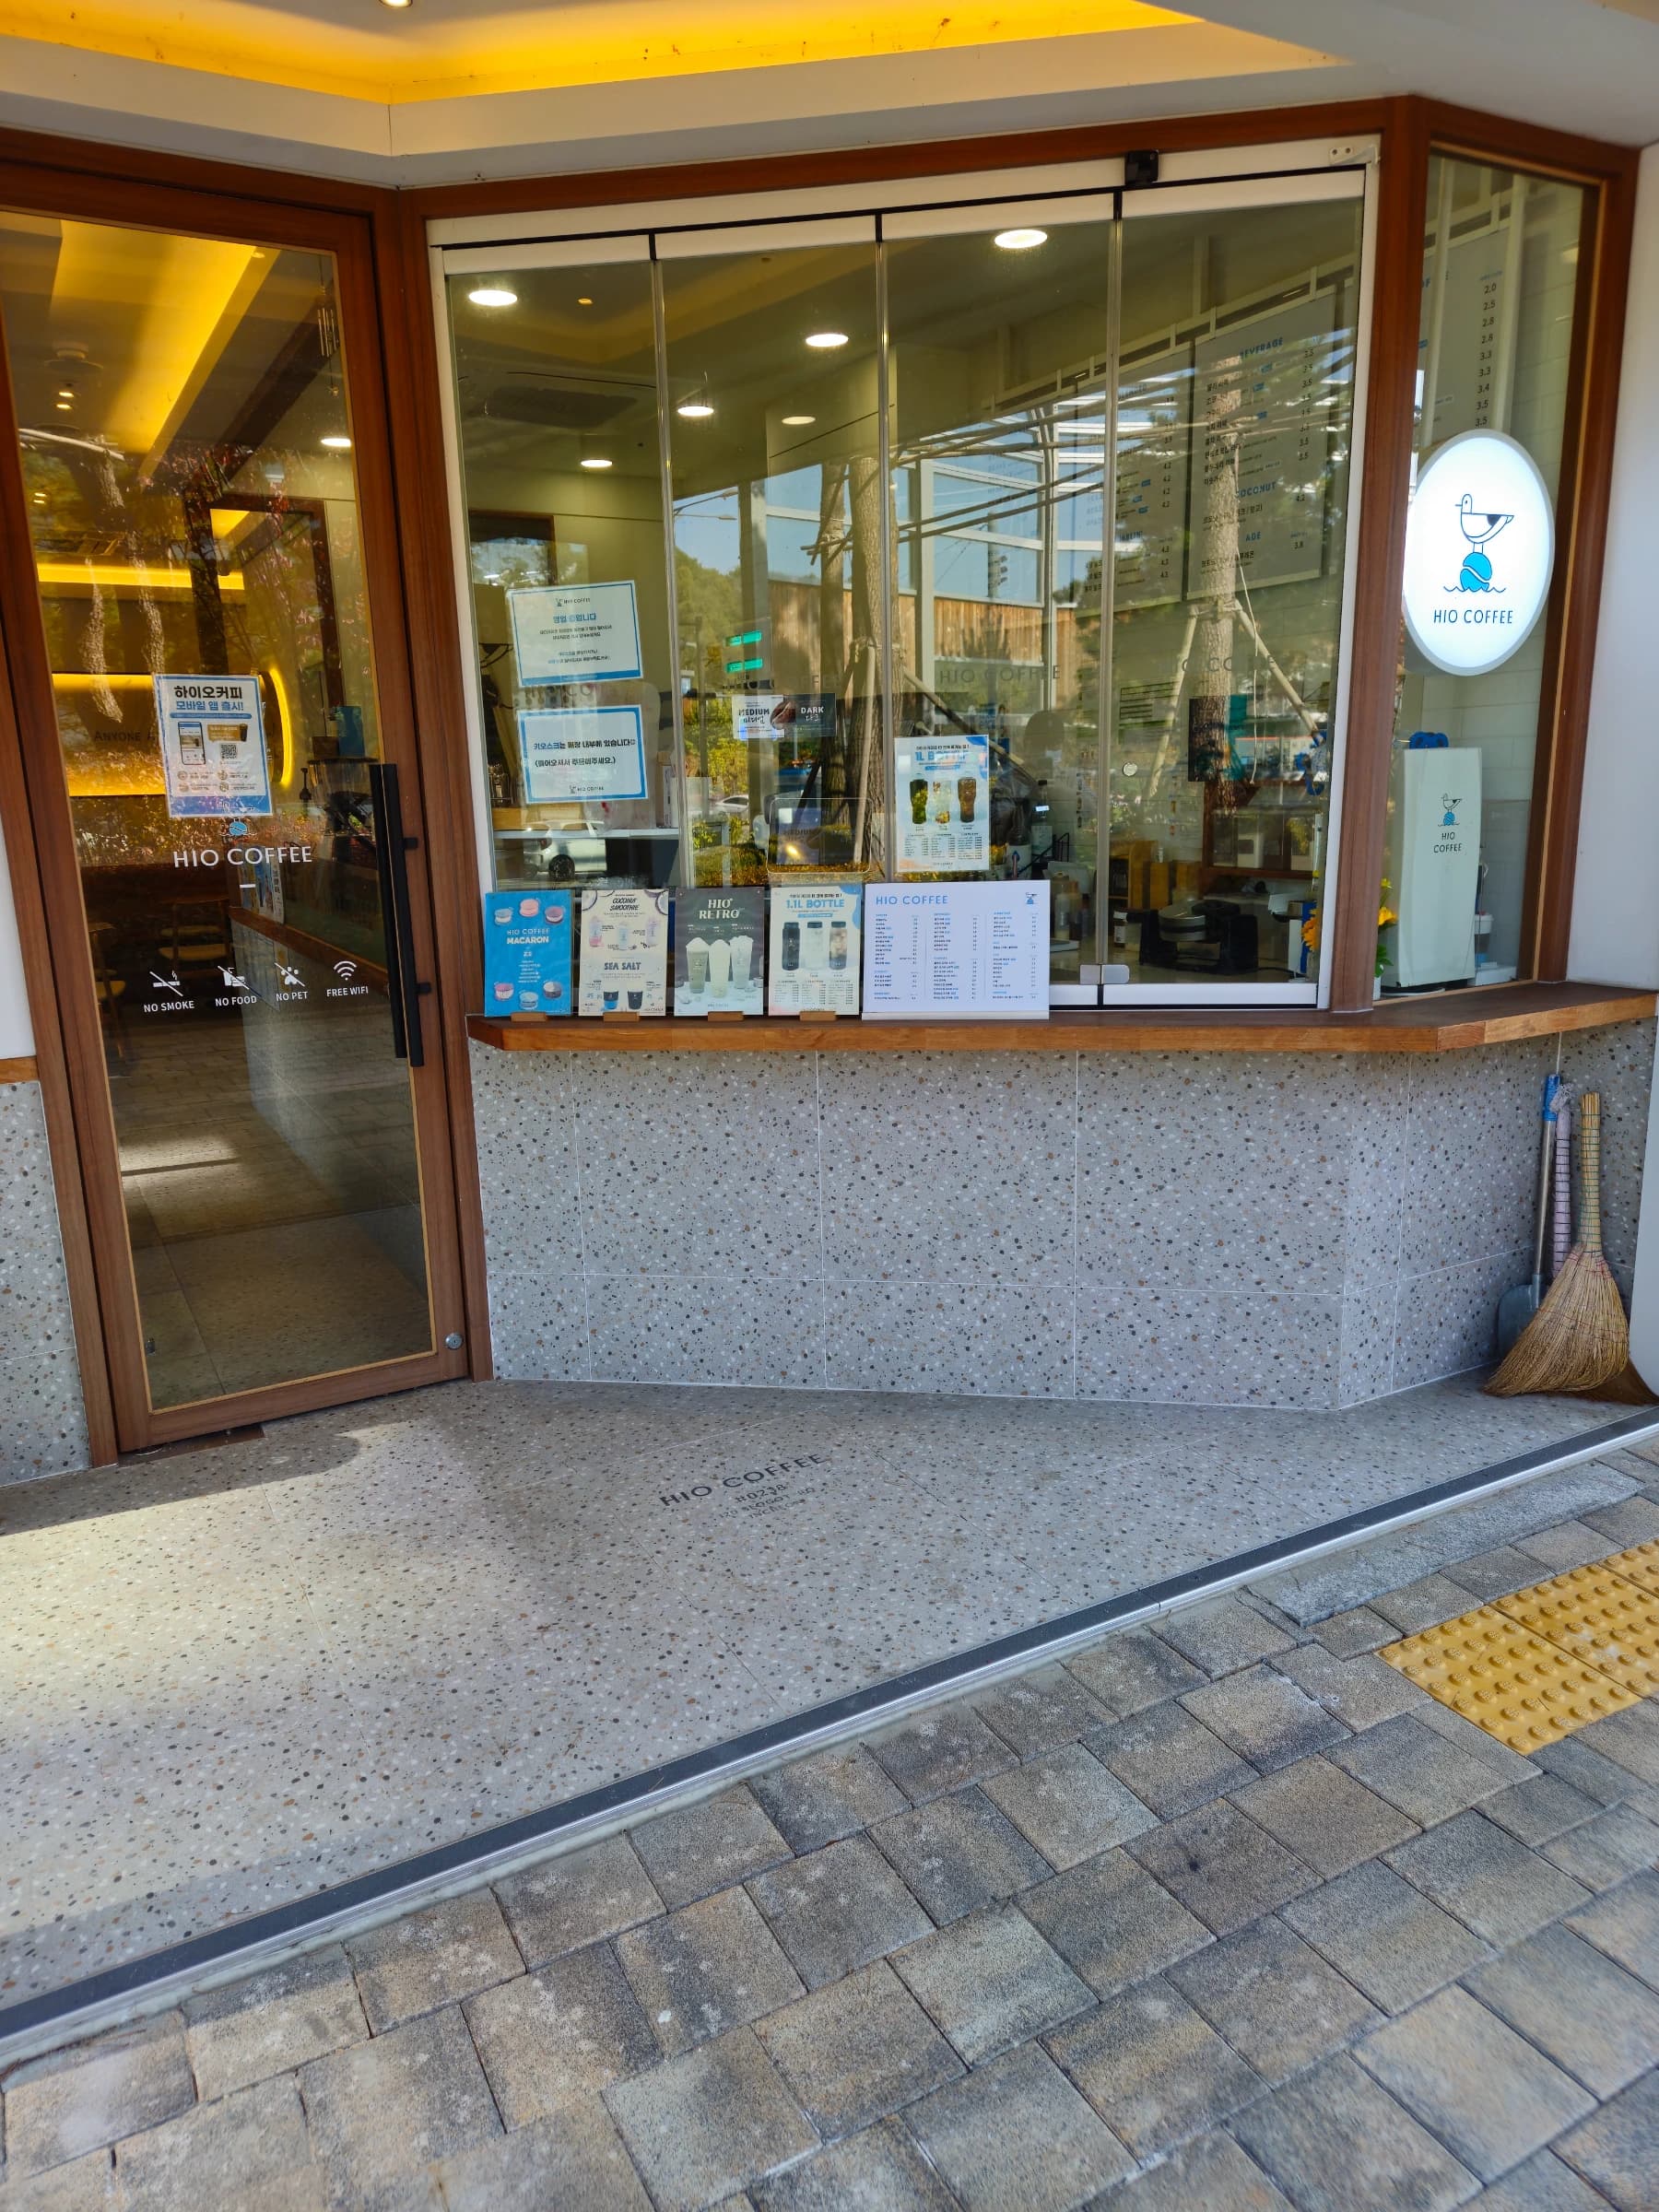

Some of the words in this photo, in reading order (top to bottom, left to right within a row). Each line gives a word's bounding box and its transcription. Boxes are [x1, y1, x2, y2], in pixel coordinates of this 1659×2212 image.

[1245, 532, 1262, 542] ADE
[1433, 609, 1458, 623] HIO
[1464, 609, 1513, 624] COFFEE
[173, 686, 242, 699] 하이오커피
[176, 700, 206, 711] 모바일
[208, 701, 218, 711] 앱
[221, 700, 243, 711] 출시!
[738, 708, 770, 716] MEDIUM
[801, 706, 824, 714] DARK
[534, 741, 566, 750] 키오스크는
[568, 740, 581, 748] 매장
[582, 739, 603, 748] 내부에
[1441, 831, 1455, 841] HIO
[1433, 842, 1463, 853] COFFEE
[173, 848, 219, 868] HIO
[227, 845, 312, 865] COFFEE
[786, 900, 803, 909] 1.1L
[806, 899, 845, 909] BOTTLE
[876, 896, 898, 905] HIO
[902, 895, 948, 905] COFFEE
[699, 909, 739, 920] RETRO
[506, 935, 549, 945] MACARON
[604, 962, 618, 971] SEA
[621, 961, 641, 971] SALT
[276, 993, 289, 1002] NO
[291, 991, 309, 1000] PET
[326, 987, 348, 997] FREE
[349, 985, 369, 995] WIFI
[215, 997, 229, 1007] NO
[231, 994, 257, 1006] FOOD
[144, 1003, 159, 1013] NO
[160, 1000, 195, 1012] SMOKE
[660, 1486, 712, 1507] HIO
[723, 1453, 827, 1488] COFFEE
